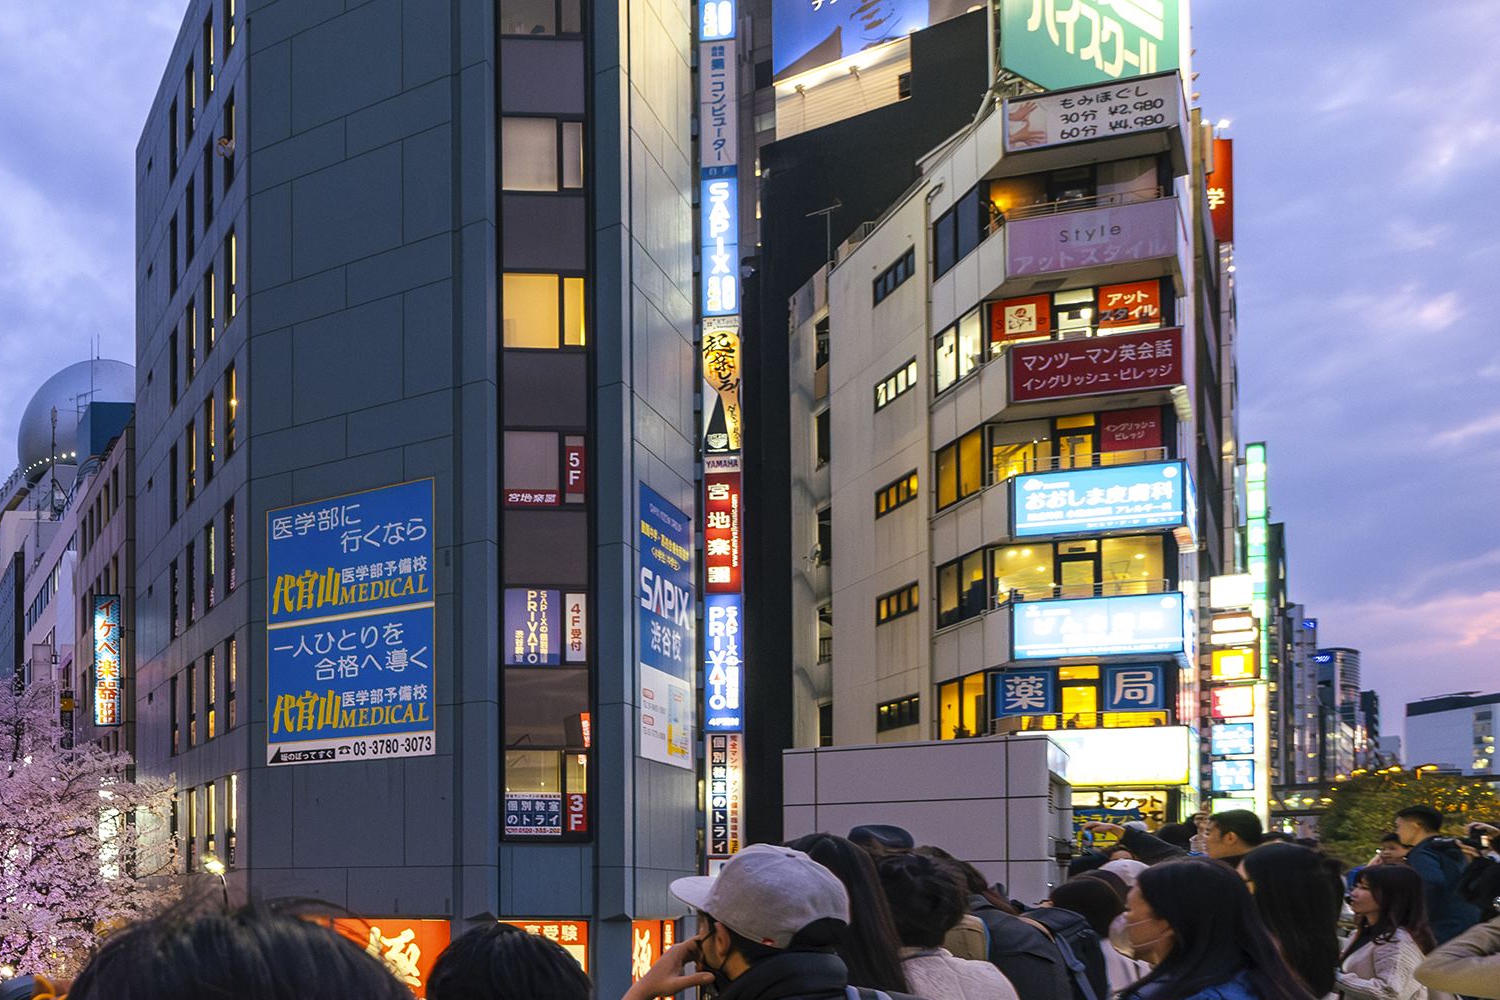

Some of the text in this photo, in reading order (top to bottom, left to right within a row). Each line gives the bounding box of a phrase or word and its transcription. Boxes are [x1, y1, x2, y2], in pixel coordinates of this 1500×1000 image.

[1060, 86, 1148, 109] もみほぐし
[1060, 110, 1098, 124] 30分
[1060, 125, 1098, 139] 60分
[708, 182, 731, 274] SAPIX
[1100, 304, 1159, 321] スタイル
[1107, 290, 1149, 306] アット
[1021, 338, 1173, 371] マンツーマン英会話
[706, 460, 738, 468] YAMAHA
[272, 503, 362, 540] 医学部に
[340, 518, 427, 554] 行くなら
[341, 555, 428, 584] 医学部予備校
[272, 567, 341, 615] 代官山
[339, 574, 429, 606] MEDICAL
[641, 566, 690, 631] SAPIX
[273, 622, 404, 658] 一人ひとりを
[526, 590, 539, 664] PRIVATO
[539, 590, 548, 663] SAPIXの
[97, 599, 118, 700] イケベ楽器
[314, 645, 428, 681] 合格へ導く
[725, 605, 739, 709] SAPIXの
[272, 689, 430, 734] 代官山 MEDICAL
[342, 683, 428, 708] 医学部予備校
[507, 800, 560, 812] 個別教室
[507, 814, 559, 825] のトライ
[570, 794, 584, 831] 3F
